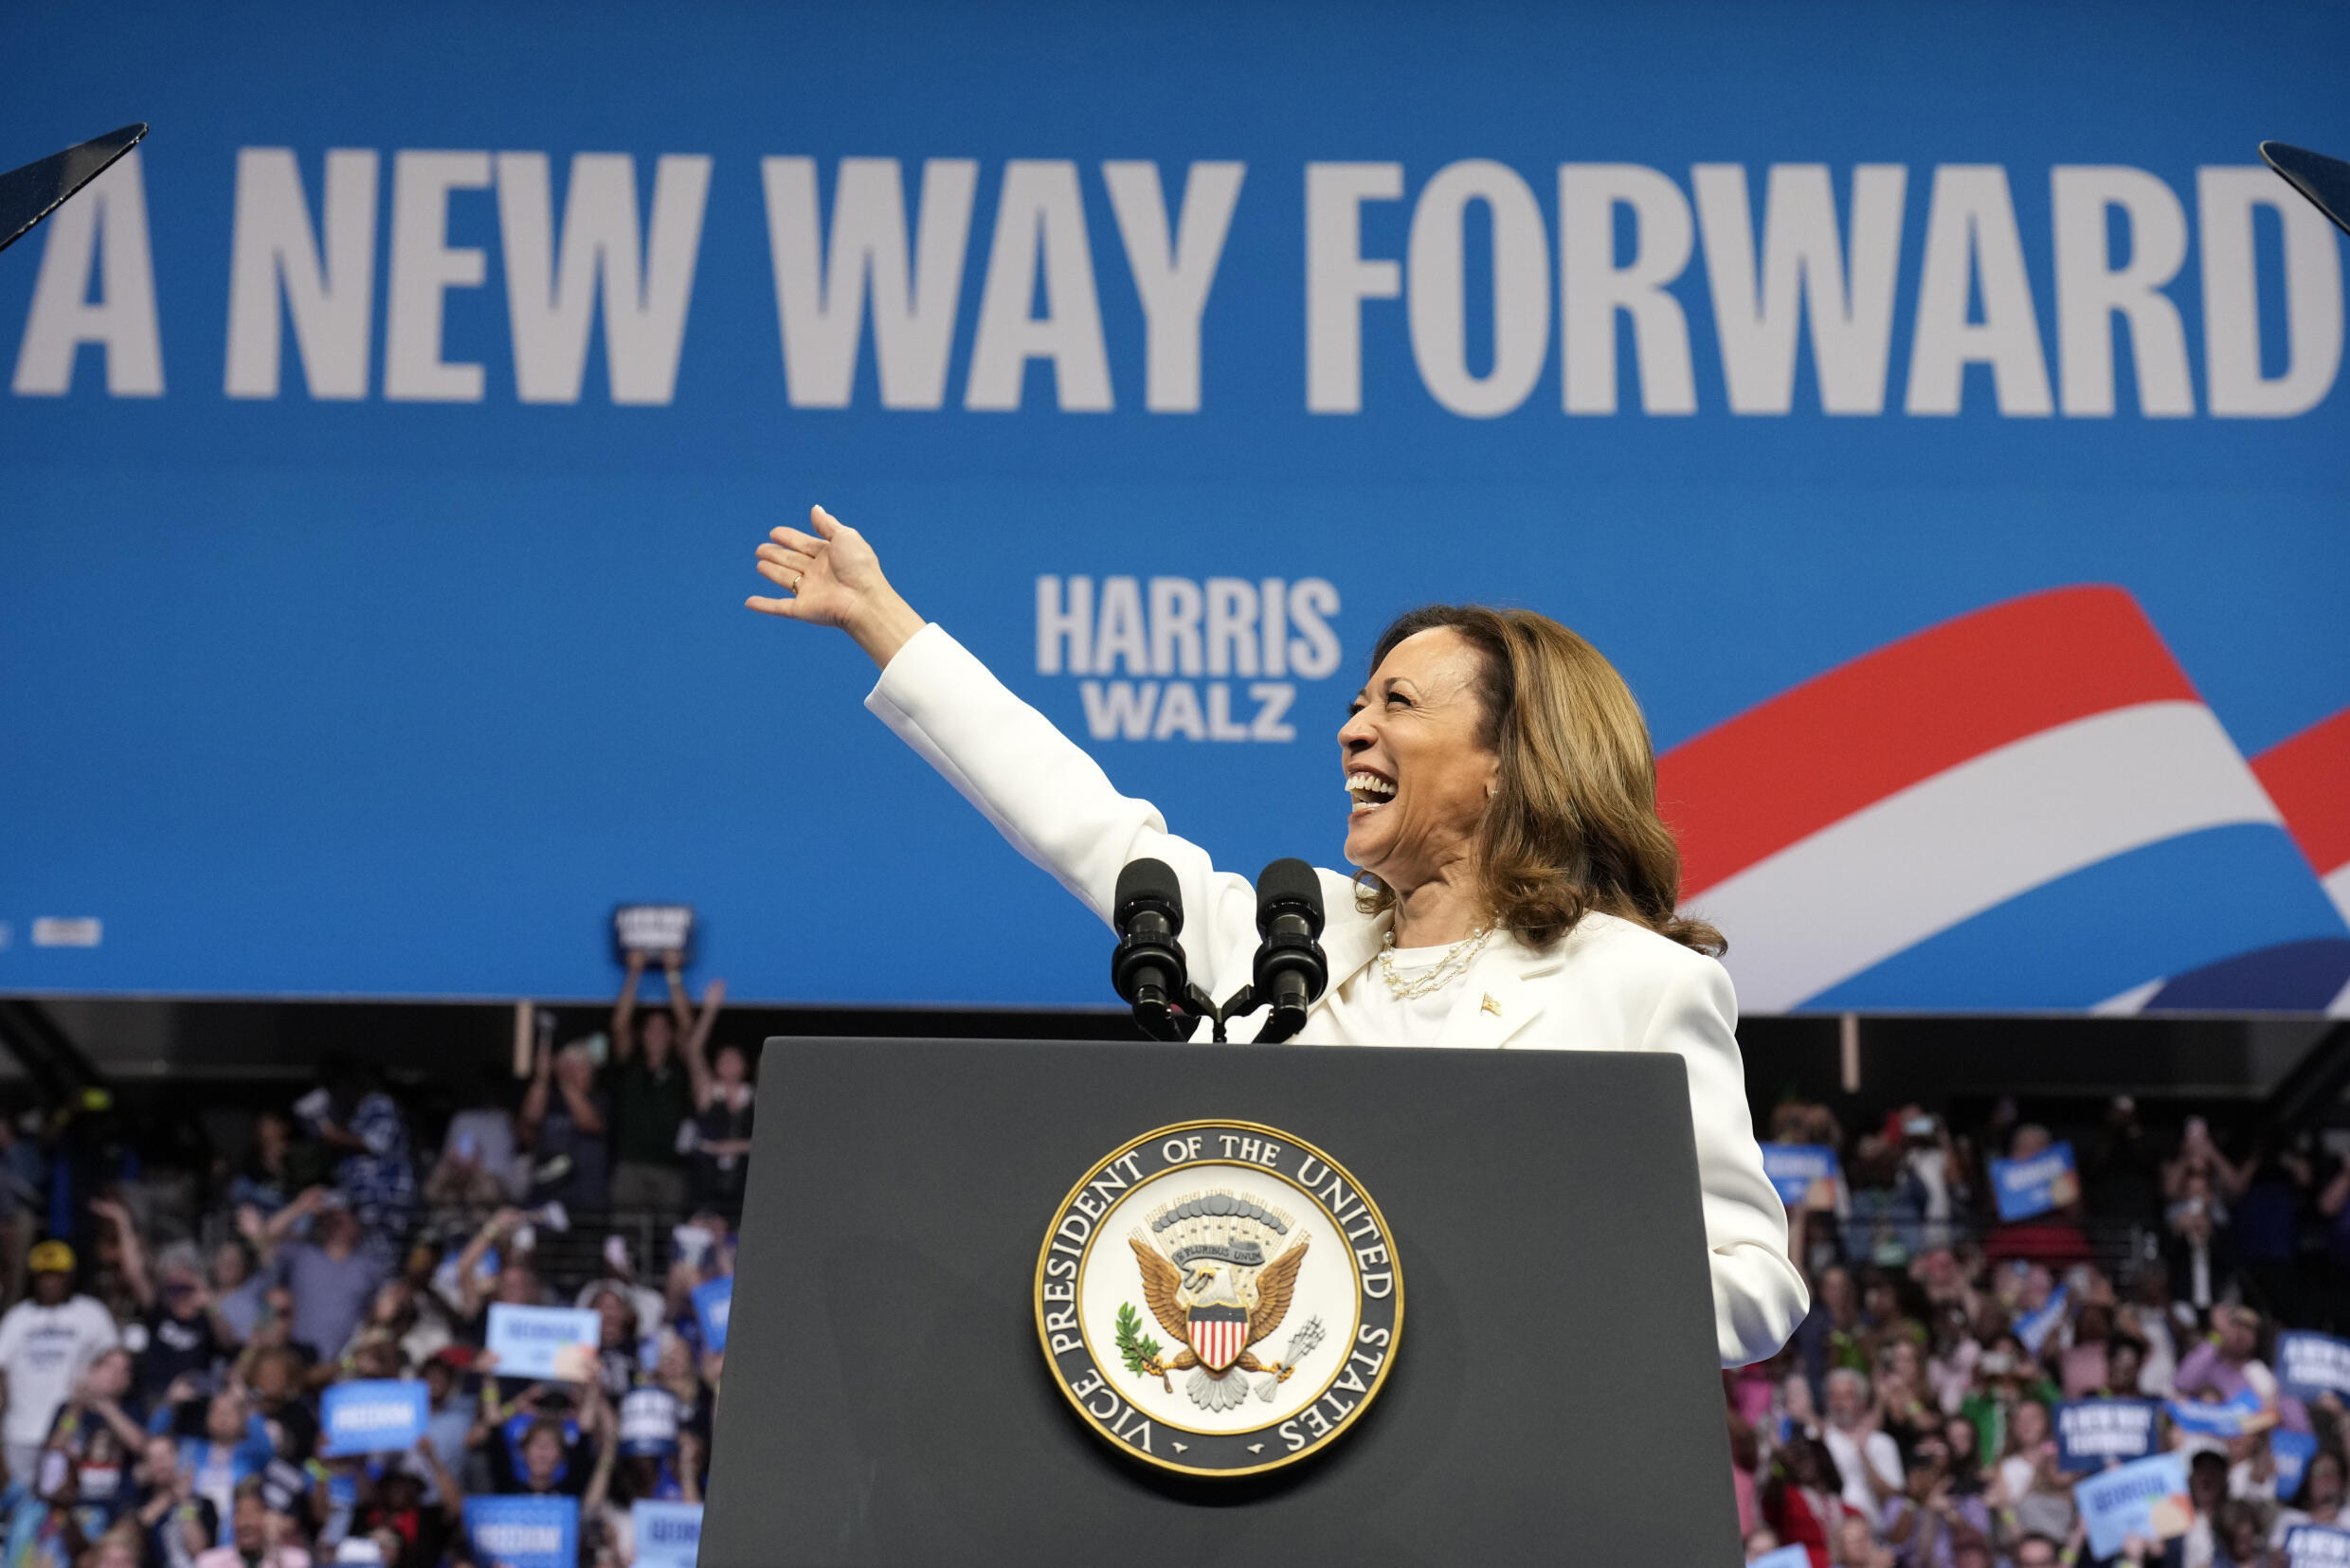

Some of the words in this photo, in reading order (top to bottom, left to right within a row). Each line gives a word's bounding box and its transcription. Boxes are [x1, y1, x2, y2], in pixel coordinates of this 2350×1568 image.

[11, 145, 165, 398] A
[225, 148, 713, 406] NEW
[762, 156, 1247, 413] WAY
[1304, 158, 2346, 419] FORWARD
[1036, 575, 1342, 679] HARRIS
[1080, 681, 1296, 743] WALZ
[1162, 1137, 1203, 1164] OF
[1219, 1135, 1282, 1168] THE
[1044, 1151, 1143, 1356] PRESIDENT
[1234, 1251, 1262, 1261] UNUM
[1296, 1155, 1394, 1300] UNITED
[1072, 1369, 1153, 1453] VICE
[1277, 1323, 1391, 1452] STATES
